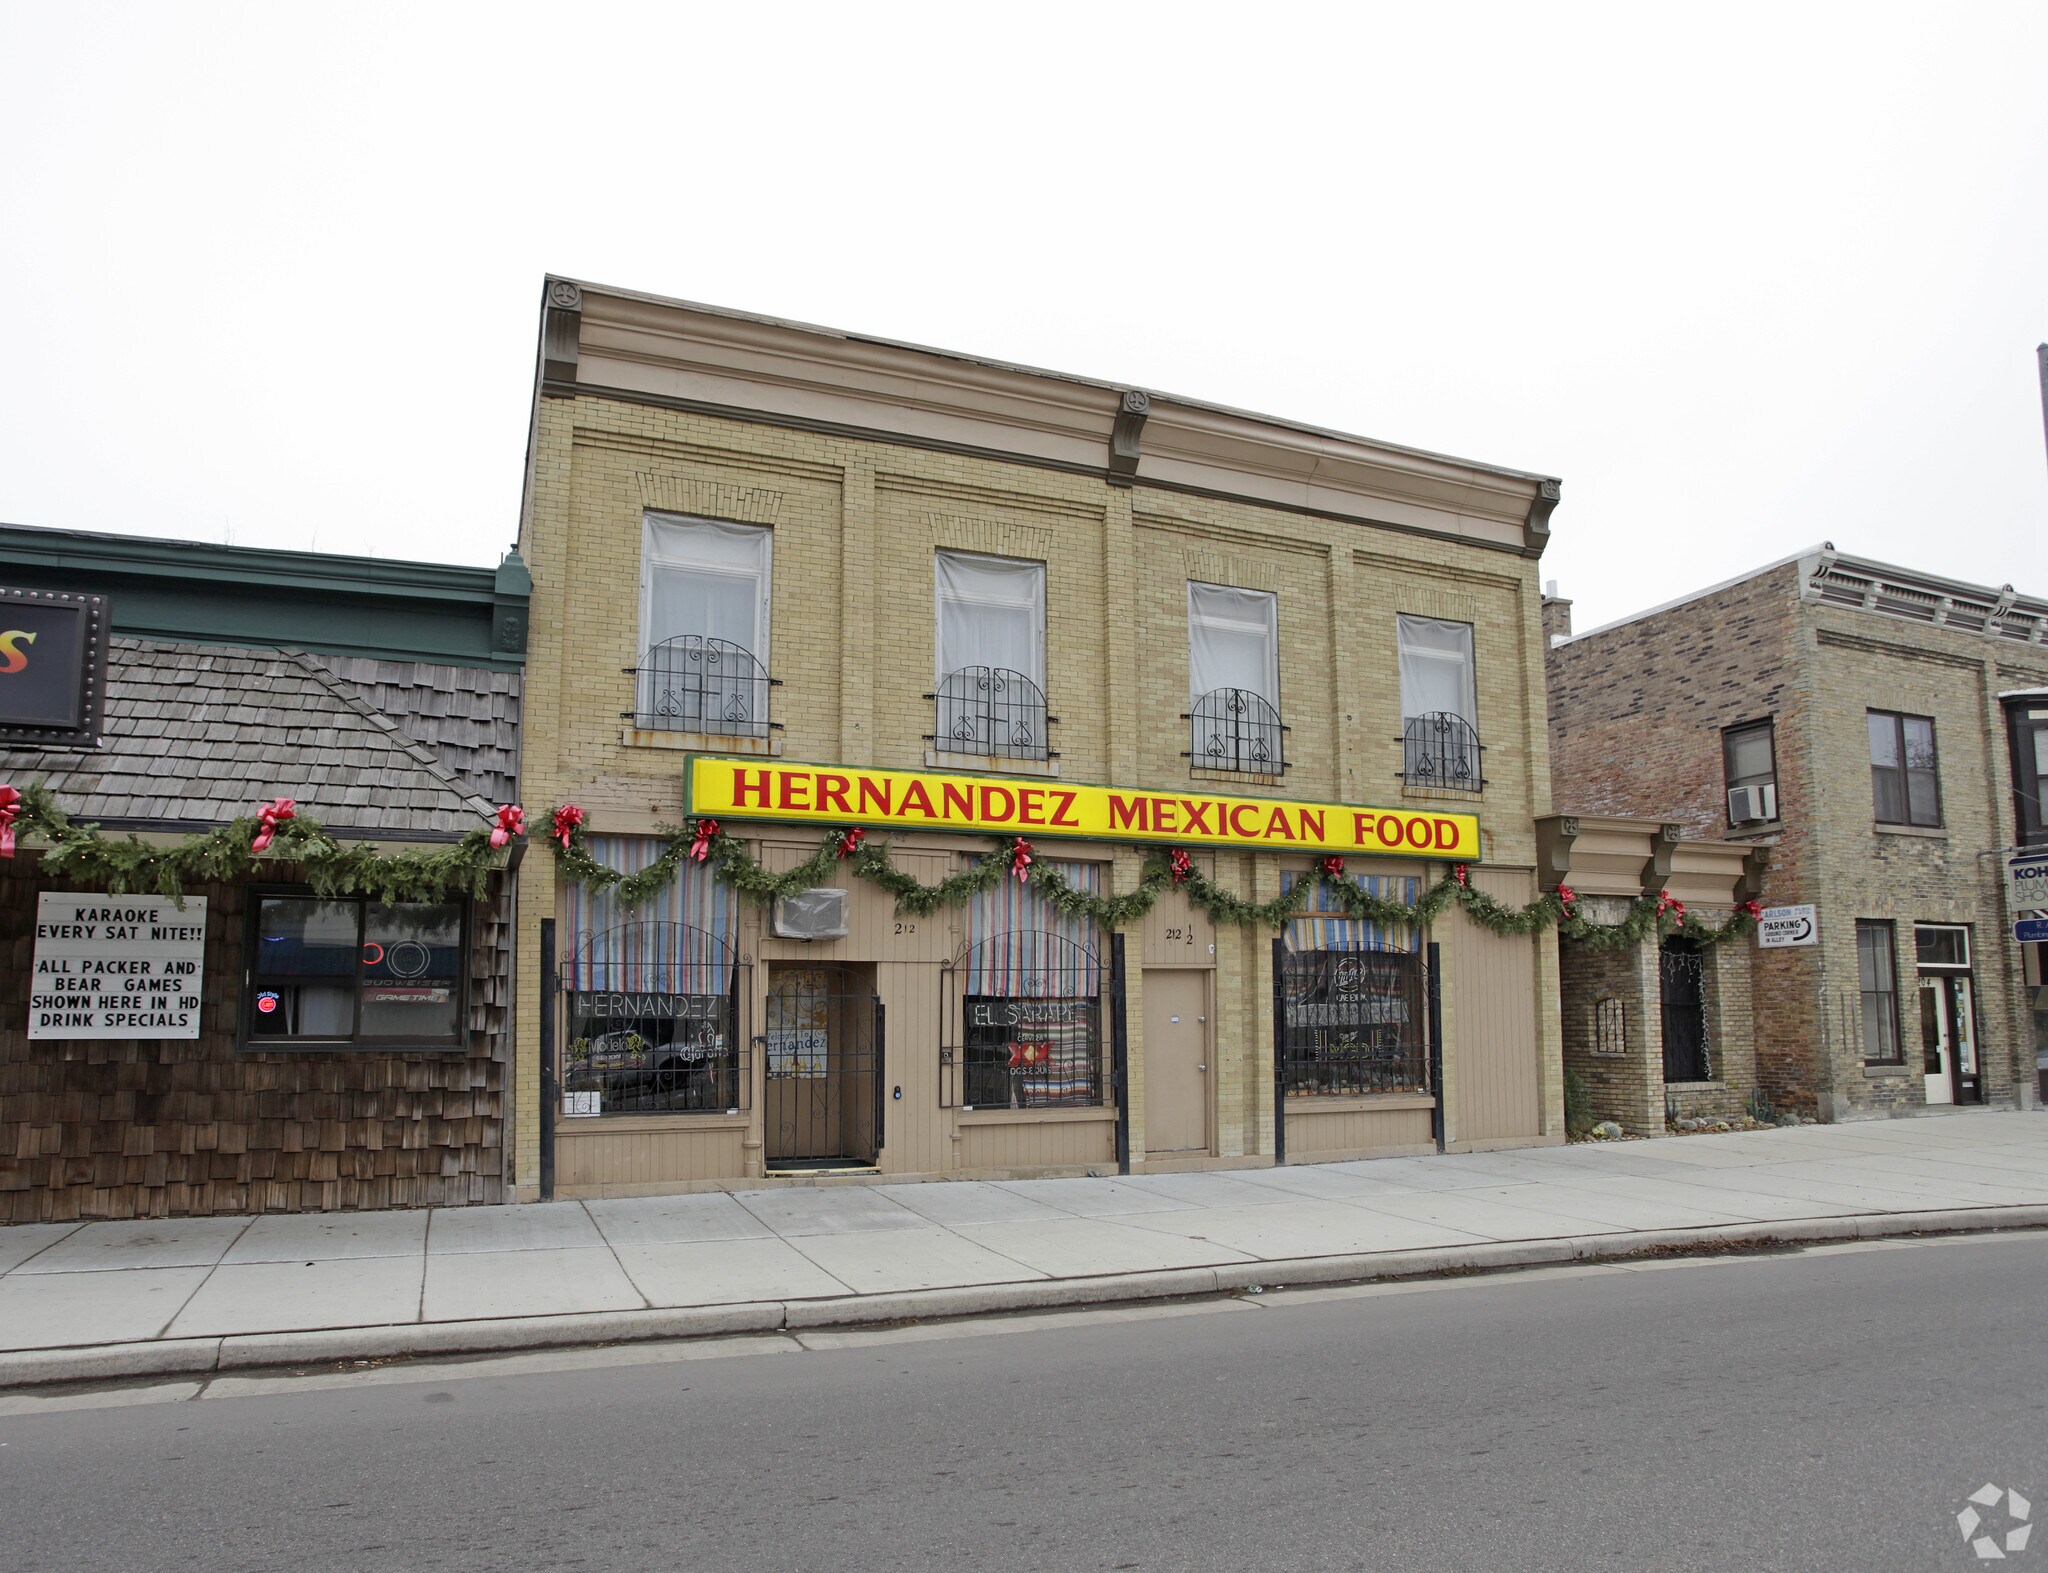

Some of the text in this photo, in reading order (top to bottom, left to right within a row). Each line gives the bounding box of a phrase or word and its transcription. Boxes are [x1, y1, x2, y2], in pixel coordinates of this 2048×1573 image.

[732, 768, 1460, 850] HERNANDEZ MEXICAN FOOD
[75, 908, 159, 923] KARAOKE
[1761, 909, 1791, 918] ARLSON
[894, 922, 915, 935] 212
[1764, 920, 1801, 931] PARKING
[37, 925, 202, 941] EVERY SAT NITE!!
[1166, 929, 1181, 939] 212
[38, 960, 195, 974] ALL PACKER AND
[55, 978, 182, 991] BEAR GAMES
[32, 995, 199, 1009] SHOWN HERE IN HD
[578, 994, 718, 1018] HERNANDEZ
[40, 1013, 188, 1027] DRINK SPECIALS
[767, 1039, 824, 1051] ernandez
